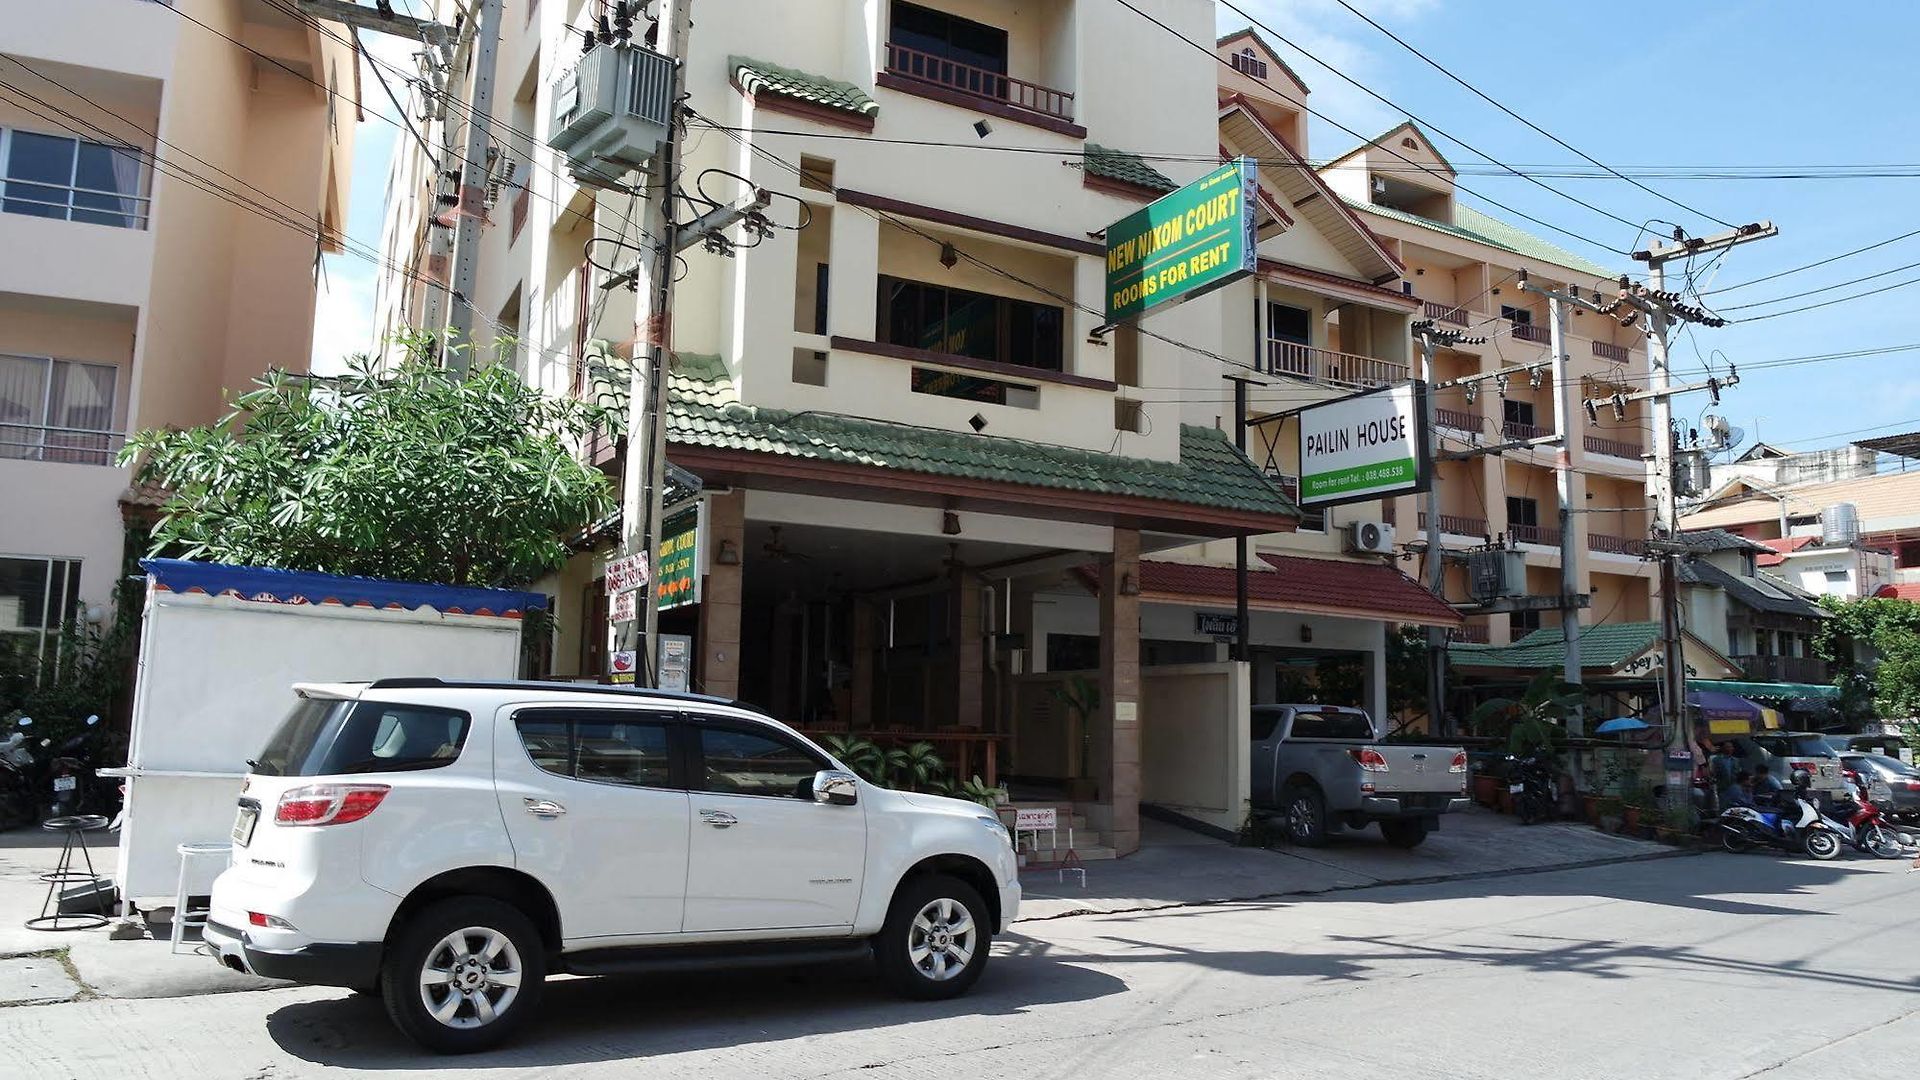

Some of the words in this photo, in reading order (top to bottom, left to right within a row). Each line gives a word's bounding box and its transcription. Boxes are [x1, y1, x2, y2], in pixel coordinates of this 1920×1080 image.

[1108, 238, 1136, 273] NEW
[1185, 187, 1239, 236] COURT
[1113, 276, 1157, 310] ROOMS
[1159, 260, 1188, 289] FOR
[1190, 242, 1230, 276] RENT
[1307, 428, 1349, 457] PAILIN
[1357, 415, 1406, 447] HOUSE
[1312, 480, 1328, 490] Room
